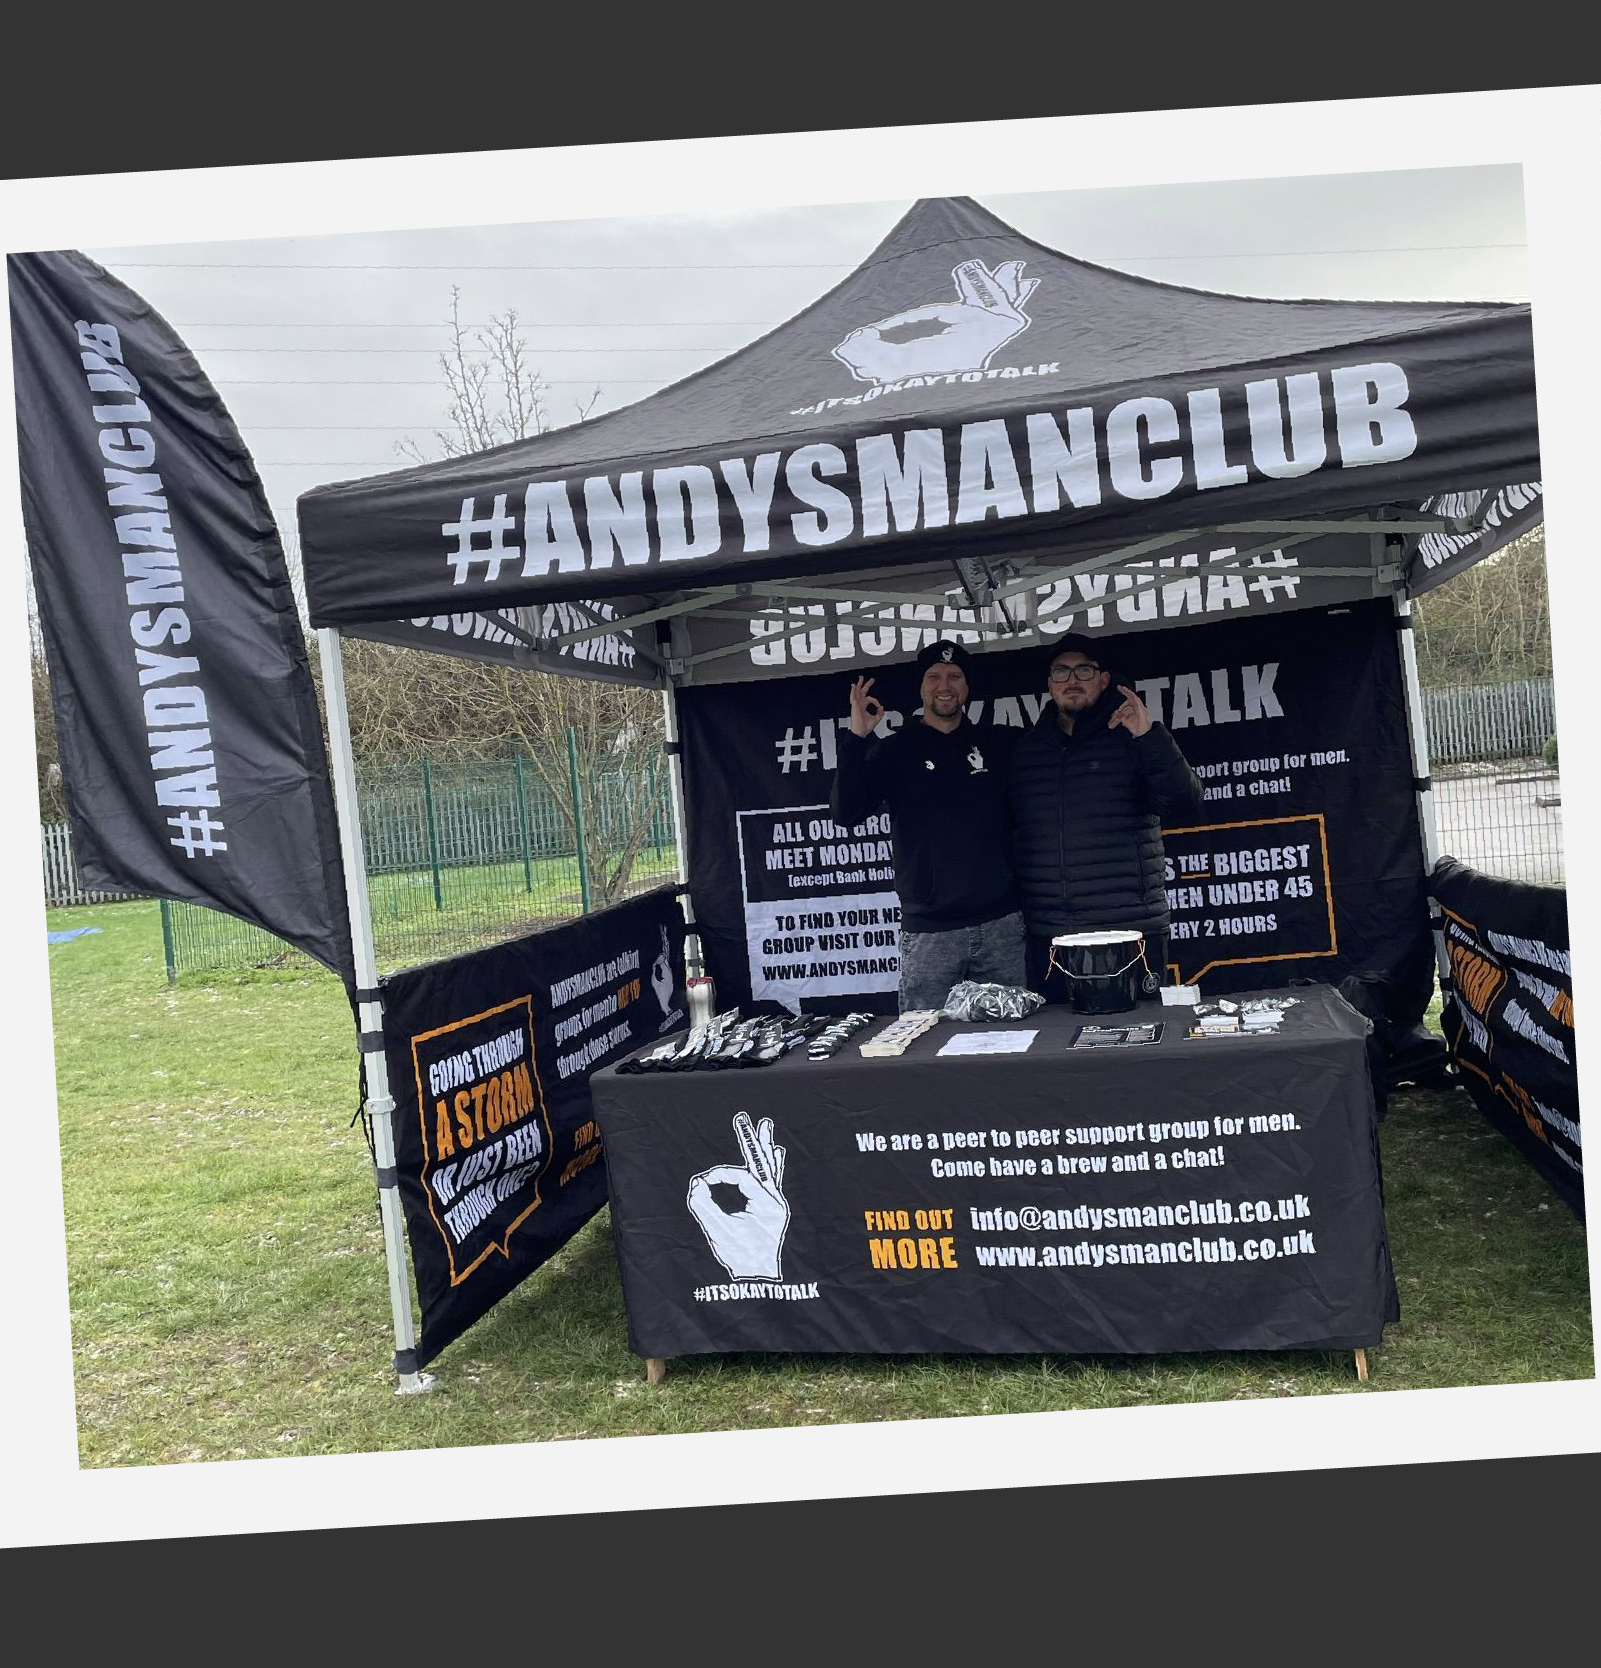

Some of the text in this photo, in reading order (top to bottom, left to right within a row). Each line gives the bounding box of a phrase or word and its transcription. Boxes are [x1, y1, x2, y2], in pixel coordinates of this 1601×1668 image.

[789, 361, 1061, 416] #ITSOKAYTOTALK
[442, 362, 1418, 585] #ANDYSMANCLUB
[74, 319, 227, 858] #ANDYSMANCLUB
[1232, 756, 1280, 776] group
[1283, 752, 1307, 769] for
[1203, 776, 1291, 800] and a chat!
[772, 821, 804, 844] ALL
[765, 846, 814, 871] MEET
[1164, 844, 1311, 882] S THE BIGGEST
[835, 868, 867, 884] Bank
[1208, 878, 1280, 906] UNDER
[1284, 875, 1314, 899] 45
[775, 906, 901, 932] TO FIND YOUR NE
[1169, 913, 1278, 941] ERY 2 HOURS
[762, 937, 815, 955] GROUP
[818, 932, 860, 951] VISIT
[862, 929, 896, 948] OUR
[428, 1027, 524, 1097] GOING THROUGH
[437, 1060, 535, 1162] A STORM
[855, 1112, 1302, 1152] We are a peer to peer support group for men.
[432, 1162, 456, 1206] OR
[456, 1140, 503, 1193] JUST
[503, 1118, 542, 1170] BEEN
[930, 1145, 1226, 1178] Come have a brew and a chat!
[443, 1177, 498, 1245] THROUGH
[864, 1208, 954, 1231] FIND OUT
[969, 1193, 1311, 1232] info@andysmanclub.co.uk
[869, 1236, 958, 1269] MORE
[974, 1229, 1317, 1267] www.andysmanclub.co.uk
[693, 1281, 821, 1302] #ITSOKAYTOTALK
